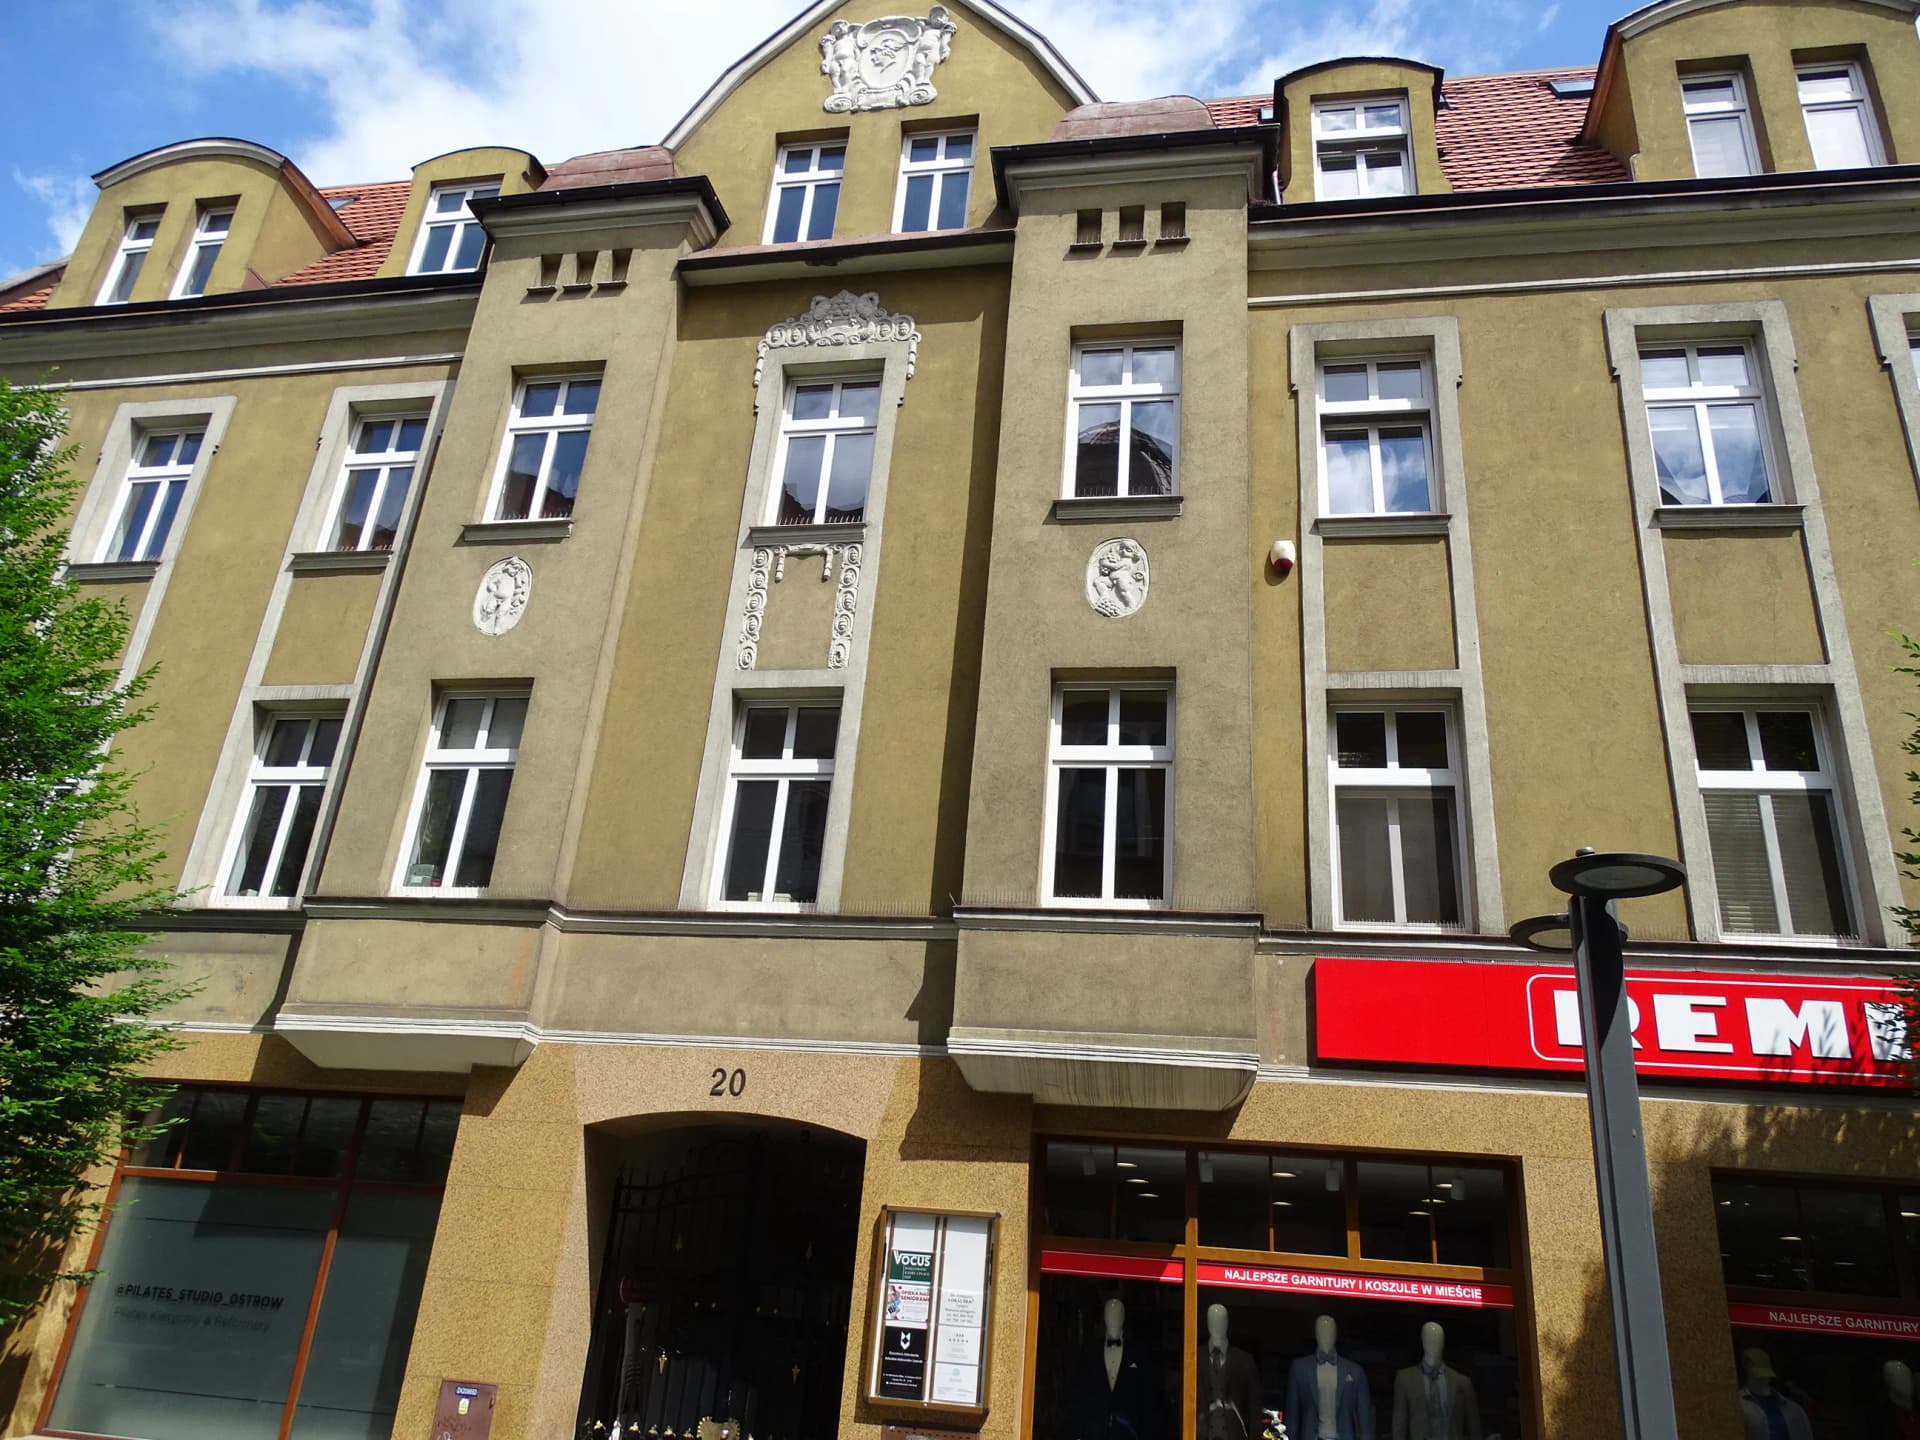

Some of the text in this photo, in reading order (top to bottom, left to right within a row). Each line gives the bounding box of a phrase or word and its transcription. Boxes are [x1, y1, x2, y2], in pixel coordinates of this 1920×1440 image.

[710, 1067, 746, 1097] 20
[893, 1250, 931, 1267] VOCUS
[115, 1284, 284, 1311] @PILATES_STUDIO_OSTROW
[1224, 1269, 1483, 1300] NAJLEPSZE GARNITURY I KOSZULE W MIEŚCIE
[1768, 1311, 1920, 1333] NAJLEPSZE GARNITURY
